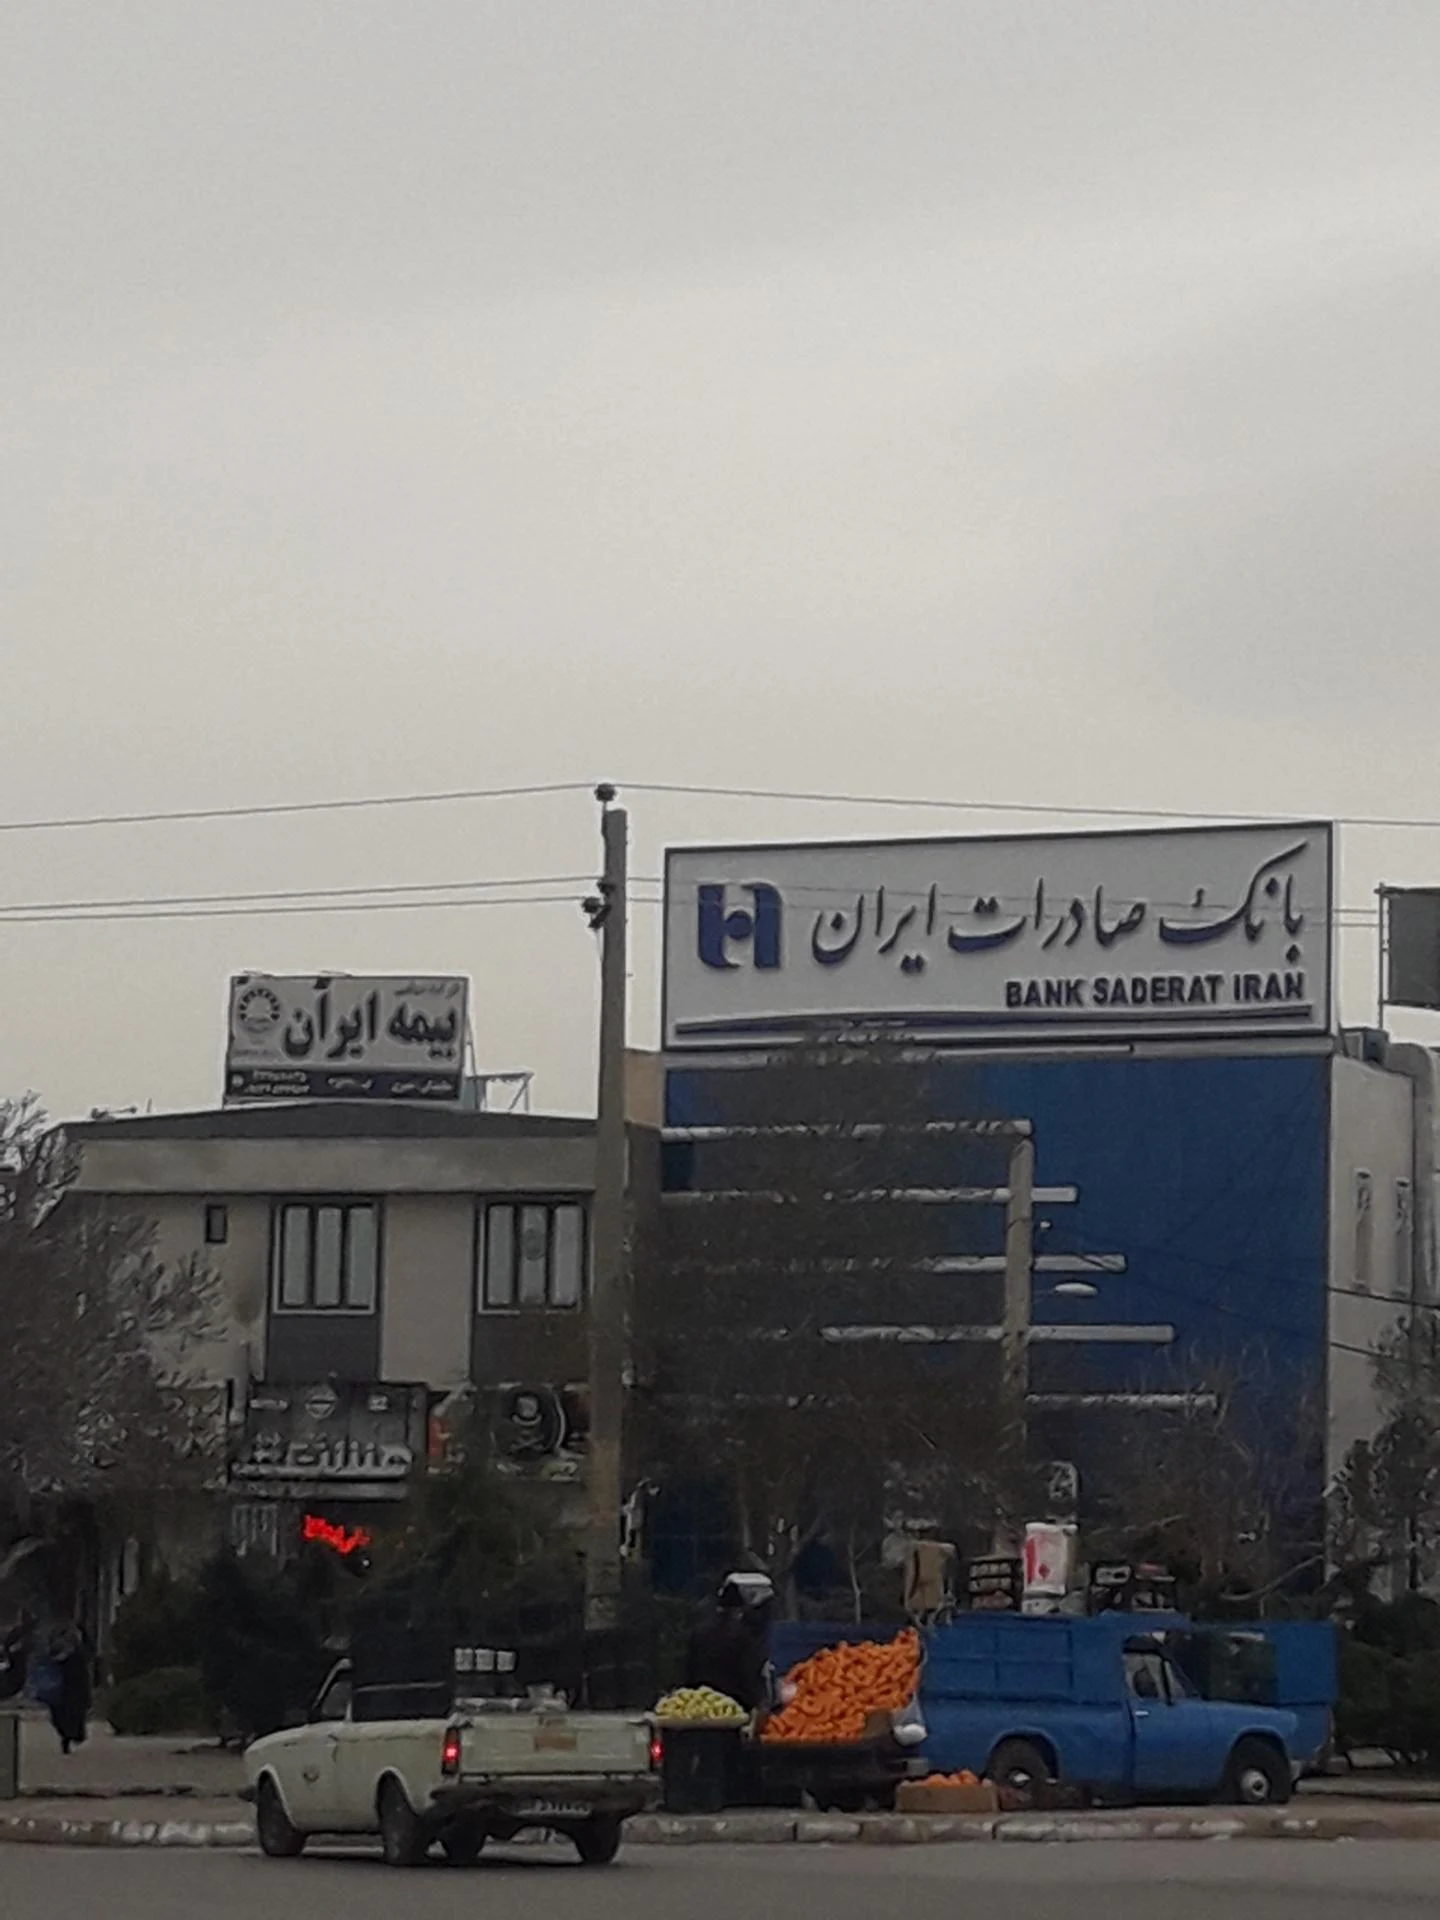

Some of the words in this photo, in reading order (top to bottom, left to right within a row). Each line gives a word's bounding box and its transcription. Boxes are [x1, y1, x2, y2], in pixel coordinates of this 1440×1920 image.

[812, 882, 938, 974] ایران
[947, 877, 1148, 955] صادرات
[1158, 841, 1309, 964] بانک
[283, 989, 379, 1058] ایران
[1006, 978, 1085, 1007] BANK
[1093, 975, 1223, 1005] SADERAT
[1234, 973, 1307, 1001] IRAN
[388, 1001, 457, 1059] بیمه
